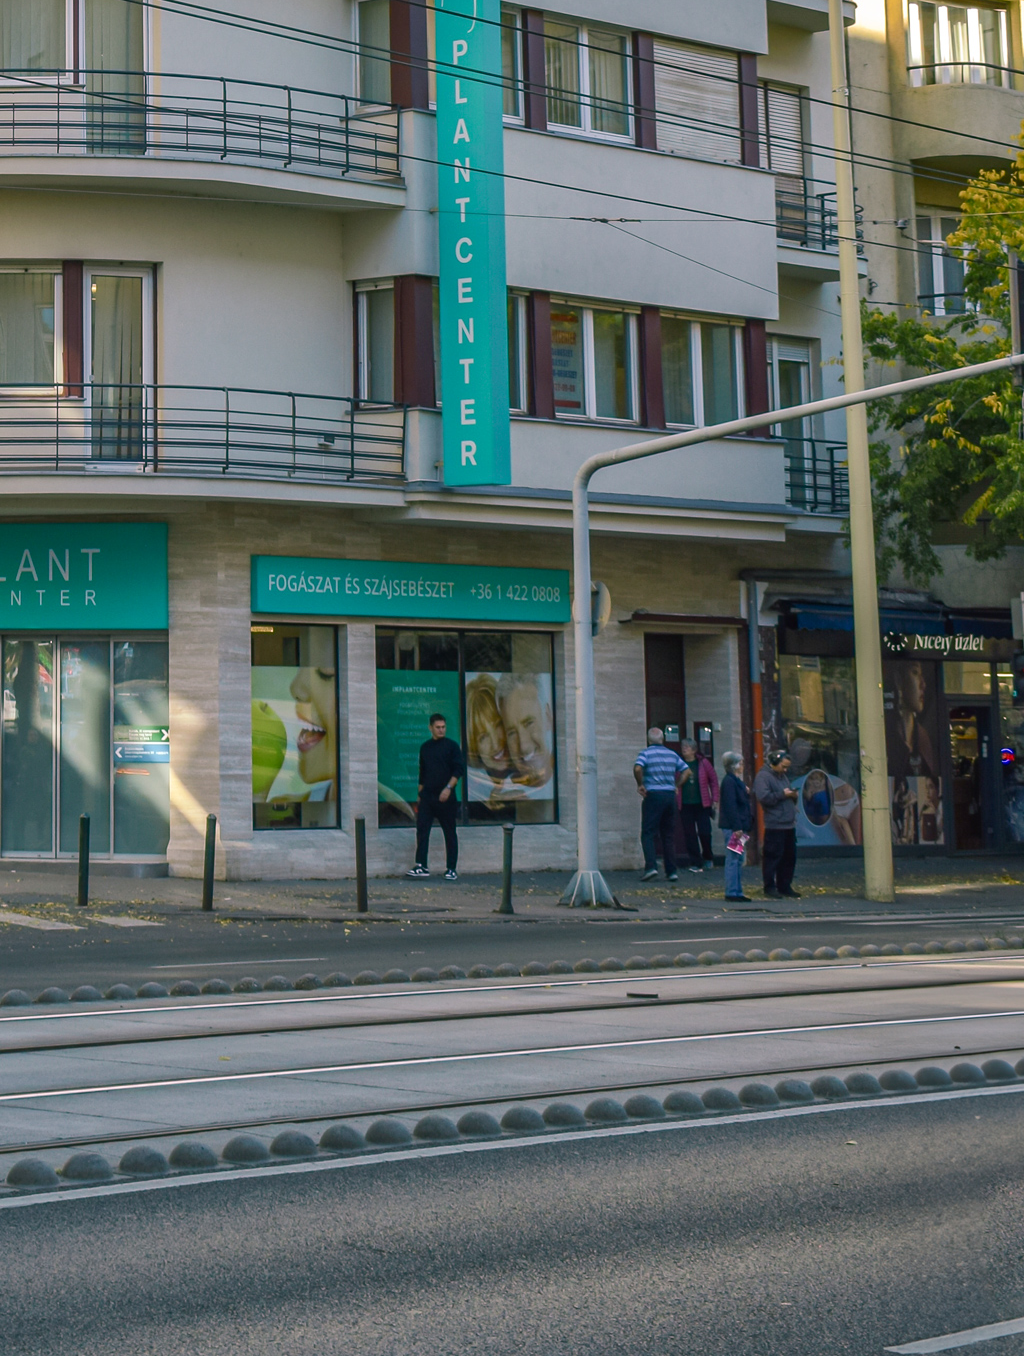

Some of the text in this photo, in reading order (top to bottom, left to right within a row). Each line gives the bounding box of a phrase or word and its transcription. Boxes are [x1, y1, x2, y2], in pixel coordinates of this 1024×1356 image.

[268, 571, 561, 602] FOGÁSZAT ÉS SZÁJSEBÉSZET +36 1 422 0808
